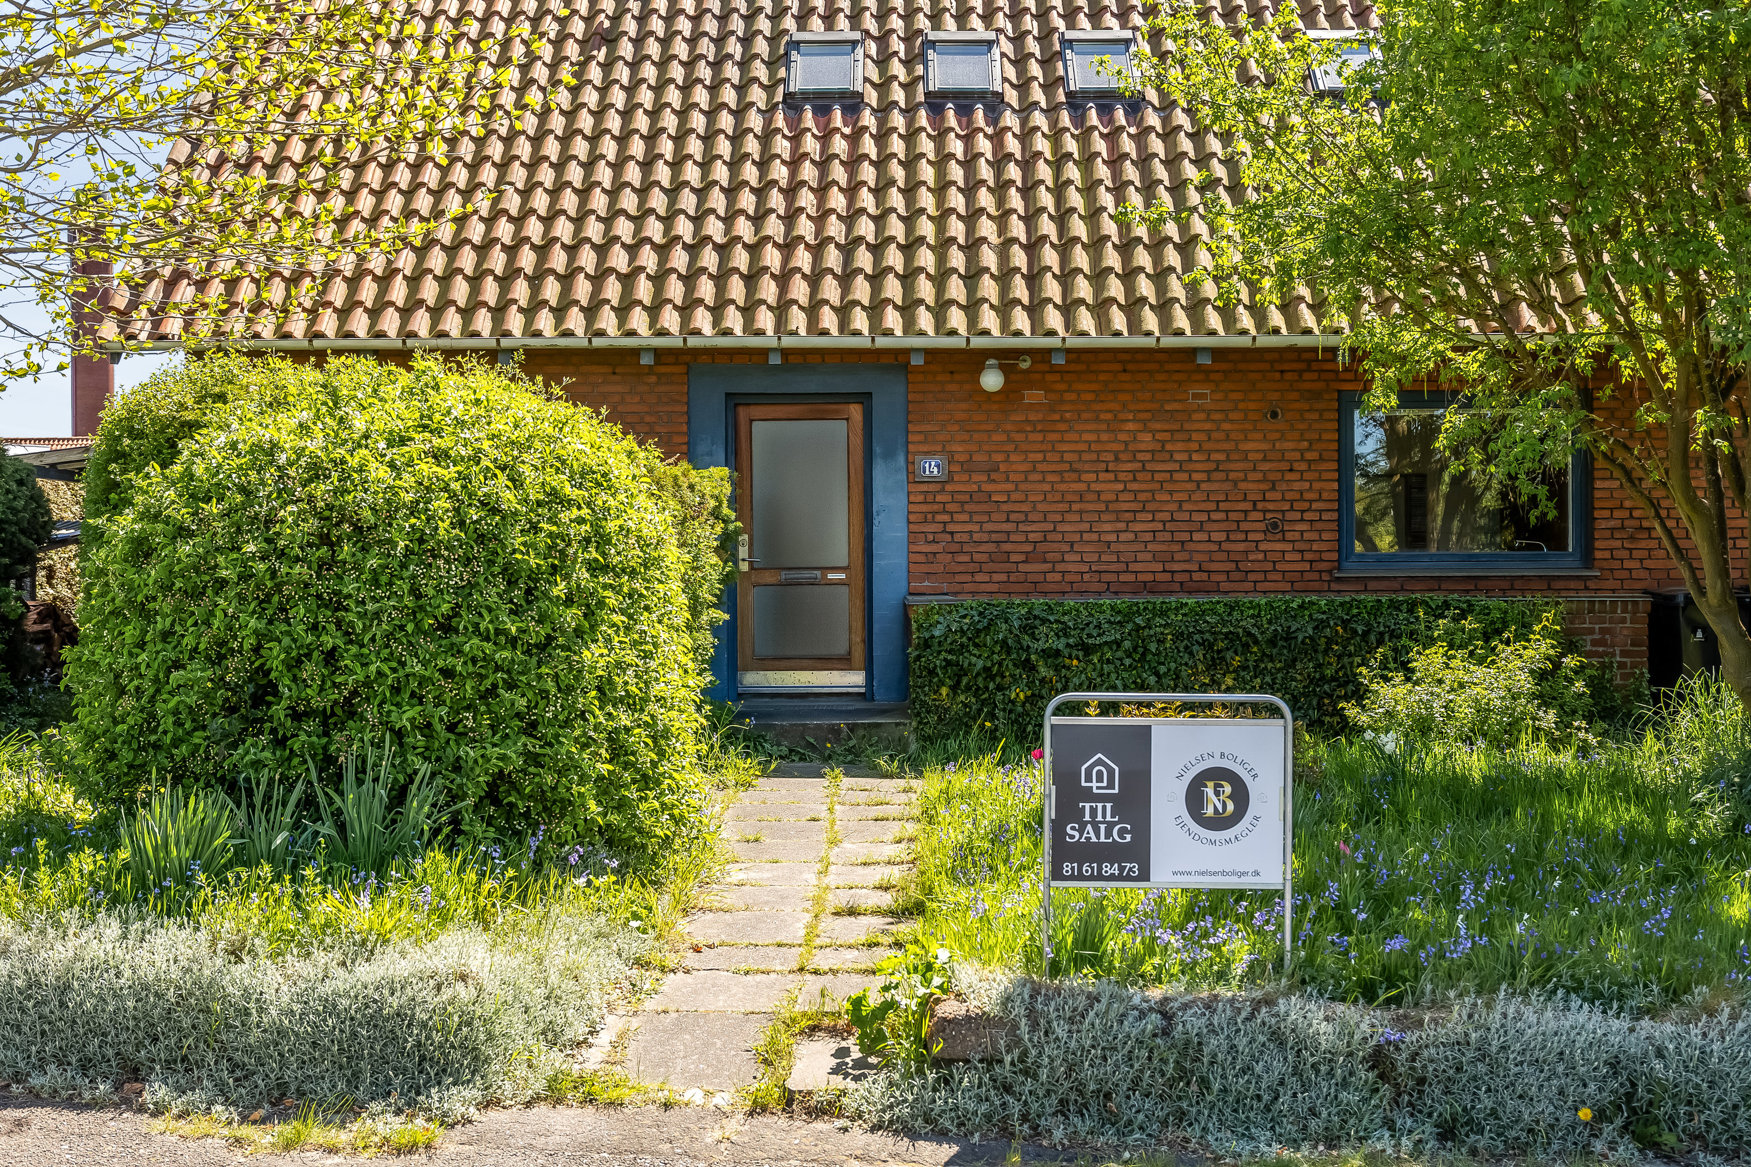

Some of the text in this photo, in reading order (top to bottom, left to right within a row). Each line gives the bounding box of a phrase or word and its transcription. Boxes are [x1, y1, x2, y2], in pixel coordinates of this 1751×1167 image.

[924, 461, 939, 475] 14
[1175, 751, 1259, 782] NIELSEN BOLIGER
[1079, 802, 1119, 821] TIL
[1065, 823, 1132, 843] SALG
[1174, 815, 1262, 847] EJENDOMSMÆGLER
[1062, 862, 1139, 877] 81 61 84 73
[1171, 868, 1262, 879] www.nielsenboliger.dk
